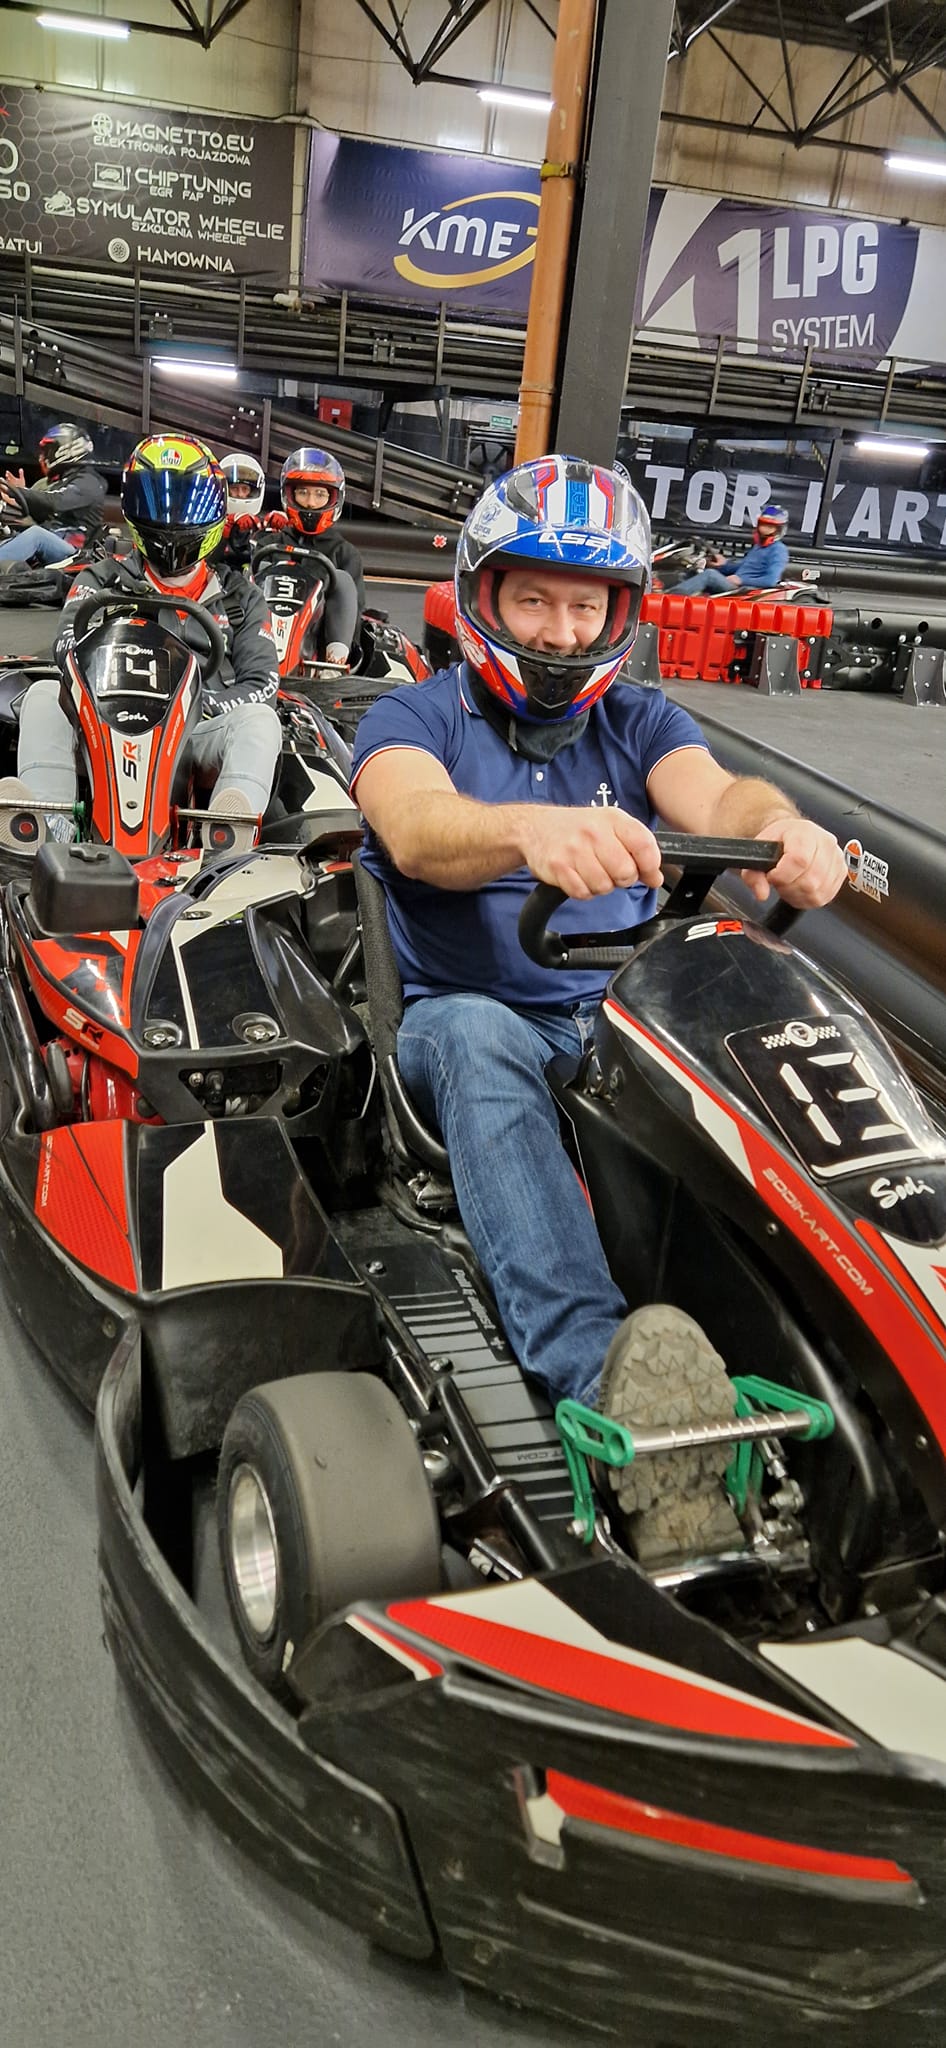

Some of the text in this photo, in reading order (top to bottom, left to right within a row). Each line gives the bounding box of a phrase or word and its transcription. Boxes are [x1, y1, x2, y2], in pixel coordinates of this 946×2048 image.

[93, 136, 250, 165] ELEKTRONIKA POJAZDOWA
[116, 120, 254, 152] MAGNETTO.EU
[135, 168, 252, 198] CHIPTUNING
[150, 186, 237, 206] EGR FAP DPF
[77, 197, 285, 241] SYMULATOR WHEELIE
[132, 221, 247, 246] SZKOLENIA WHEELIE
[398, 207, 521, 259] KME
[138, 245, 235, 273] HAMOWNIA
[772, 221, 879, 299] LPG
[771, 312, 875, 352] SYSTEM
[645, 465, 772, 527] TOR
[111, 656, 158, 689] 14
[122, 740, 138, 783] SR
[864, 855, 886, 876] RACING
[779, 1051, 908, 1146] 13
[870, 1176, 936, 1209] Sodi
[762, 1168, 874, 1296] SODIKART.COM
